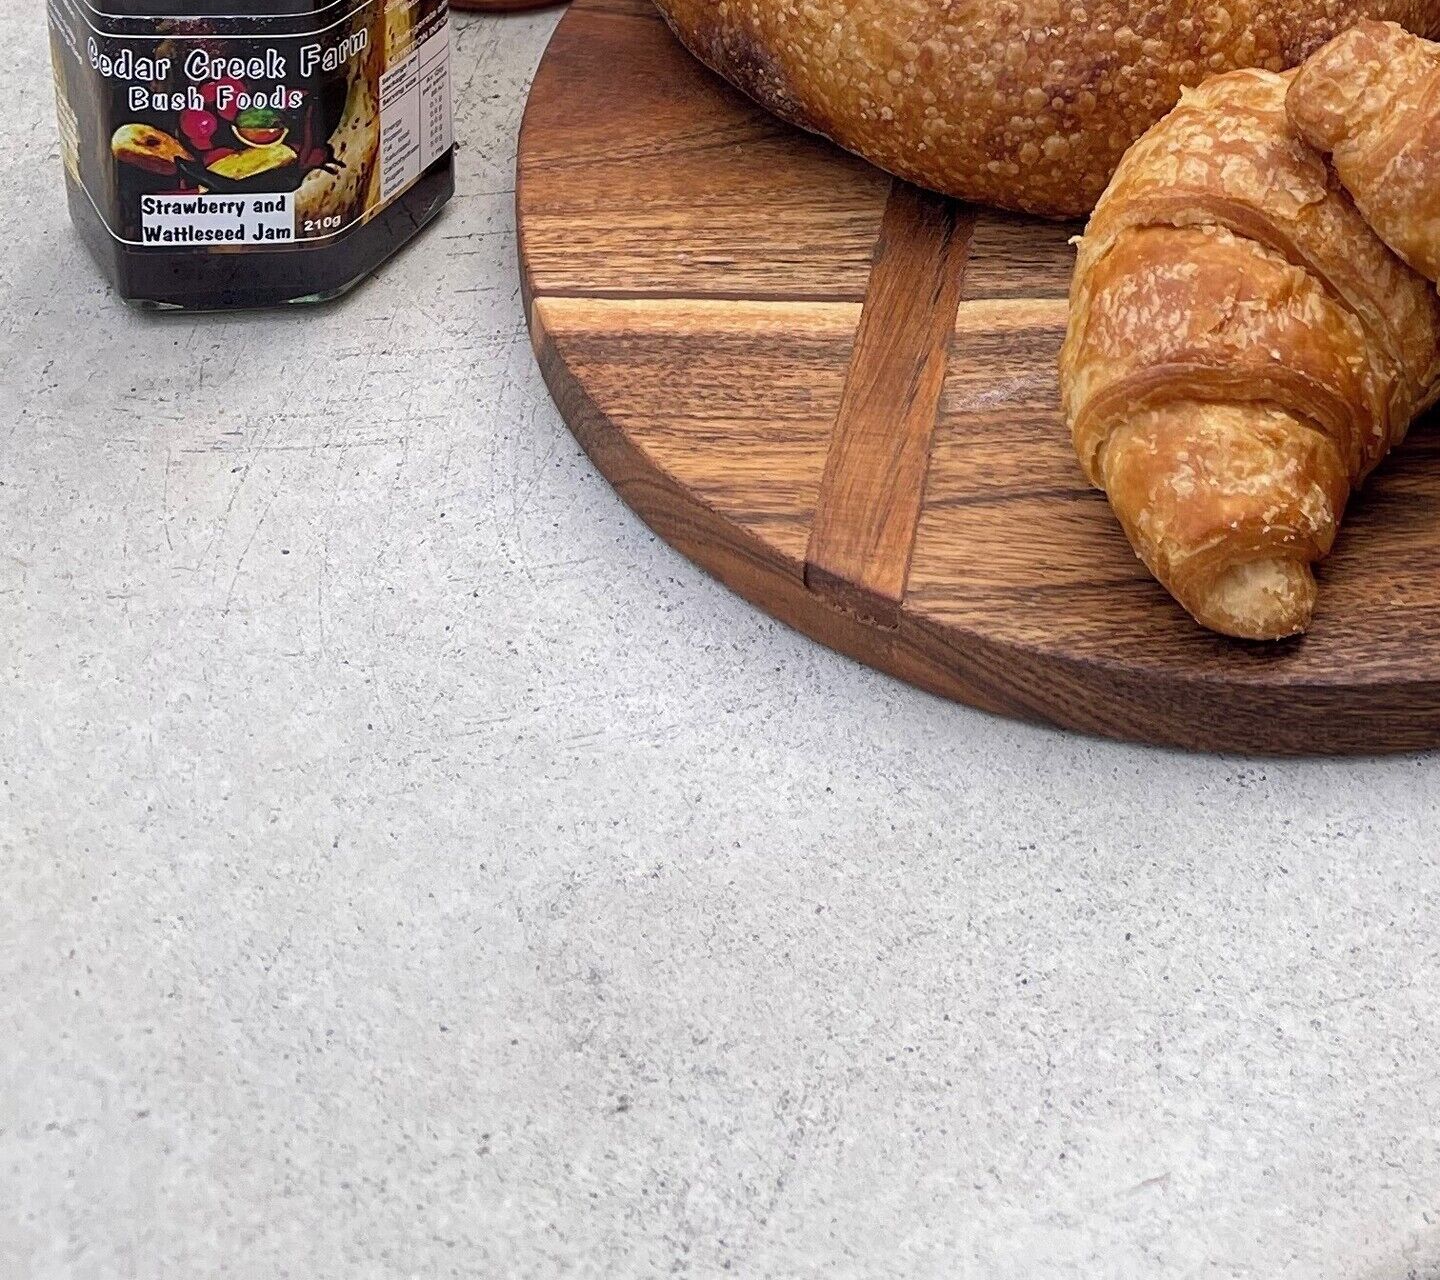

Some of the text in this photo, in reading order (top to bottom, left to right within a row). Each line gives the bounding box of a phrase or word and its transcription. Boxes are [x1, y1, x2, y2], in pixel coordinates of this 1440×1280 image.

[87, 36, 171, 81] Cedar
[184, 48, 287, 80] Creek
[299, 27, 368, 78] Farm
[128, 85, 304, 112] Bush Foods
[141, 195, 286, 217] Strawberry and
[143, 222, 292, 243] Wattleseed Jam
[303, 215, 342, 232] 210g
